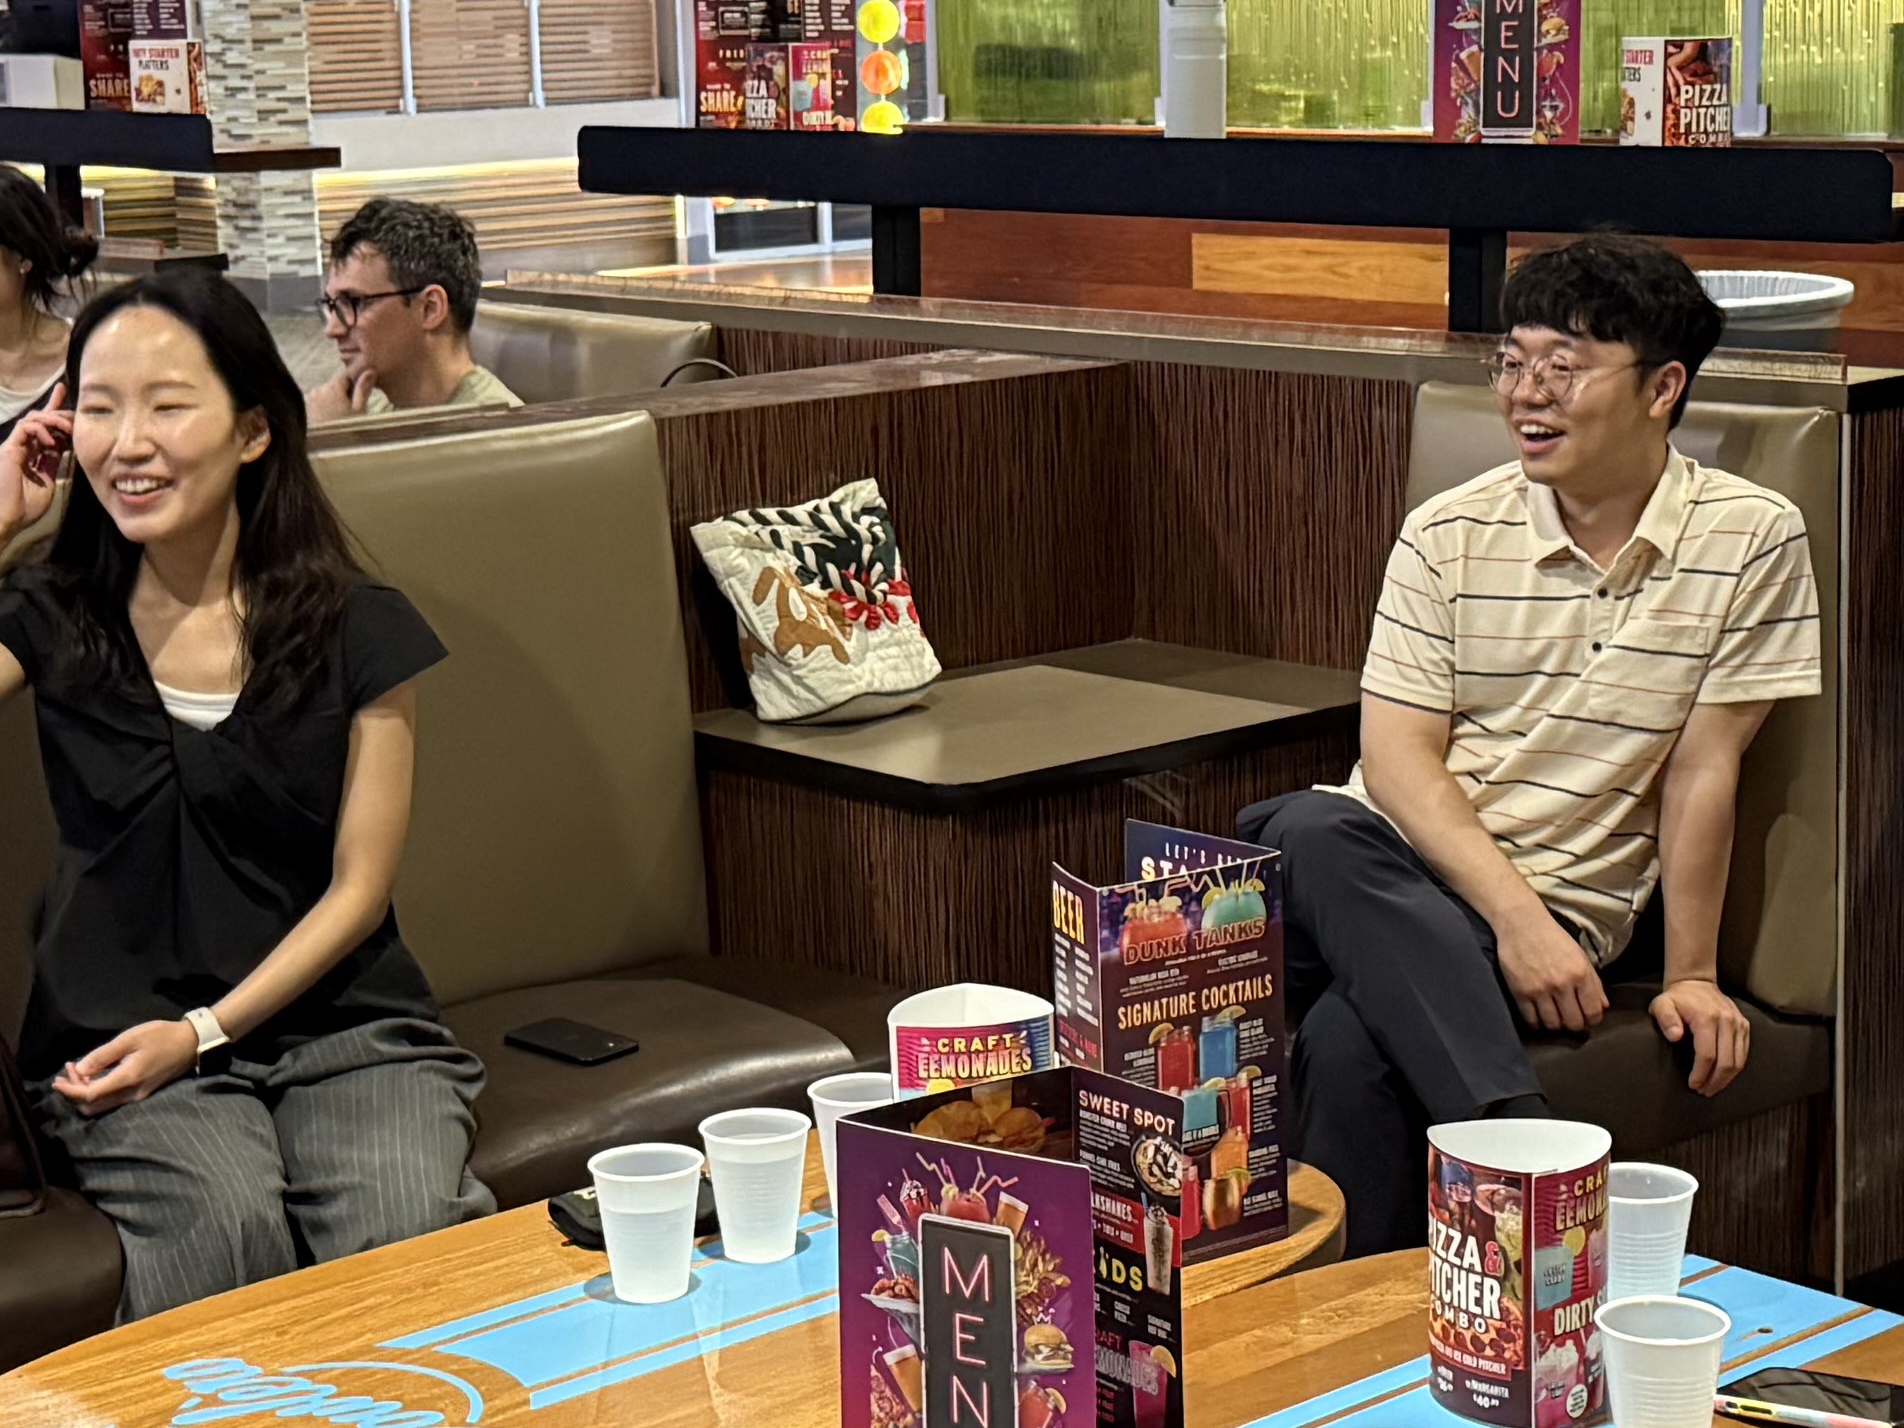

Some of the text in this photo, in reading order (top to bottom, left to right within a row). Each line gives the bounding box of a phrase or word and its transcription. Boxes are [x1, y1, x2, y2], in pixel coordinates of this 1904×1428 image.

[1625, 49, 1654, 66] STARTER
[699, 90, 736, 113] SHARE
[1680, 84, 1728, 108] PIZZA
[1165, 842, 1206, 864] LET'S
[1141, 856, 1204, 882] STA
[1052, 880, 1085, 945] BEER
[1125, 932, 1188, 966] DUNK
[1194, 918, 1267, 951] TANKS
[1118, 991, 1198, 1031] SIGNATURE
[1202, 974, 1274, 1012] COCKTAILS
[937, 1033, 1014, 1054] CRAFT
[1079, 1090, 1130, 1121] SWEET
[1134, 1108, 1176, 1136] SPOT
[1484, 1240, 1505, 1277] &
[1554, 1294, 1595, 1337] DIRTY
